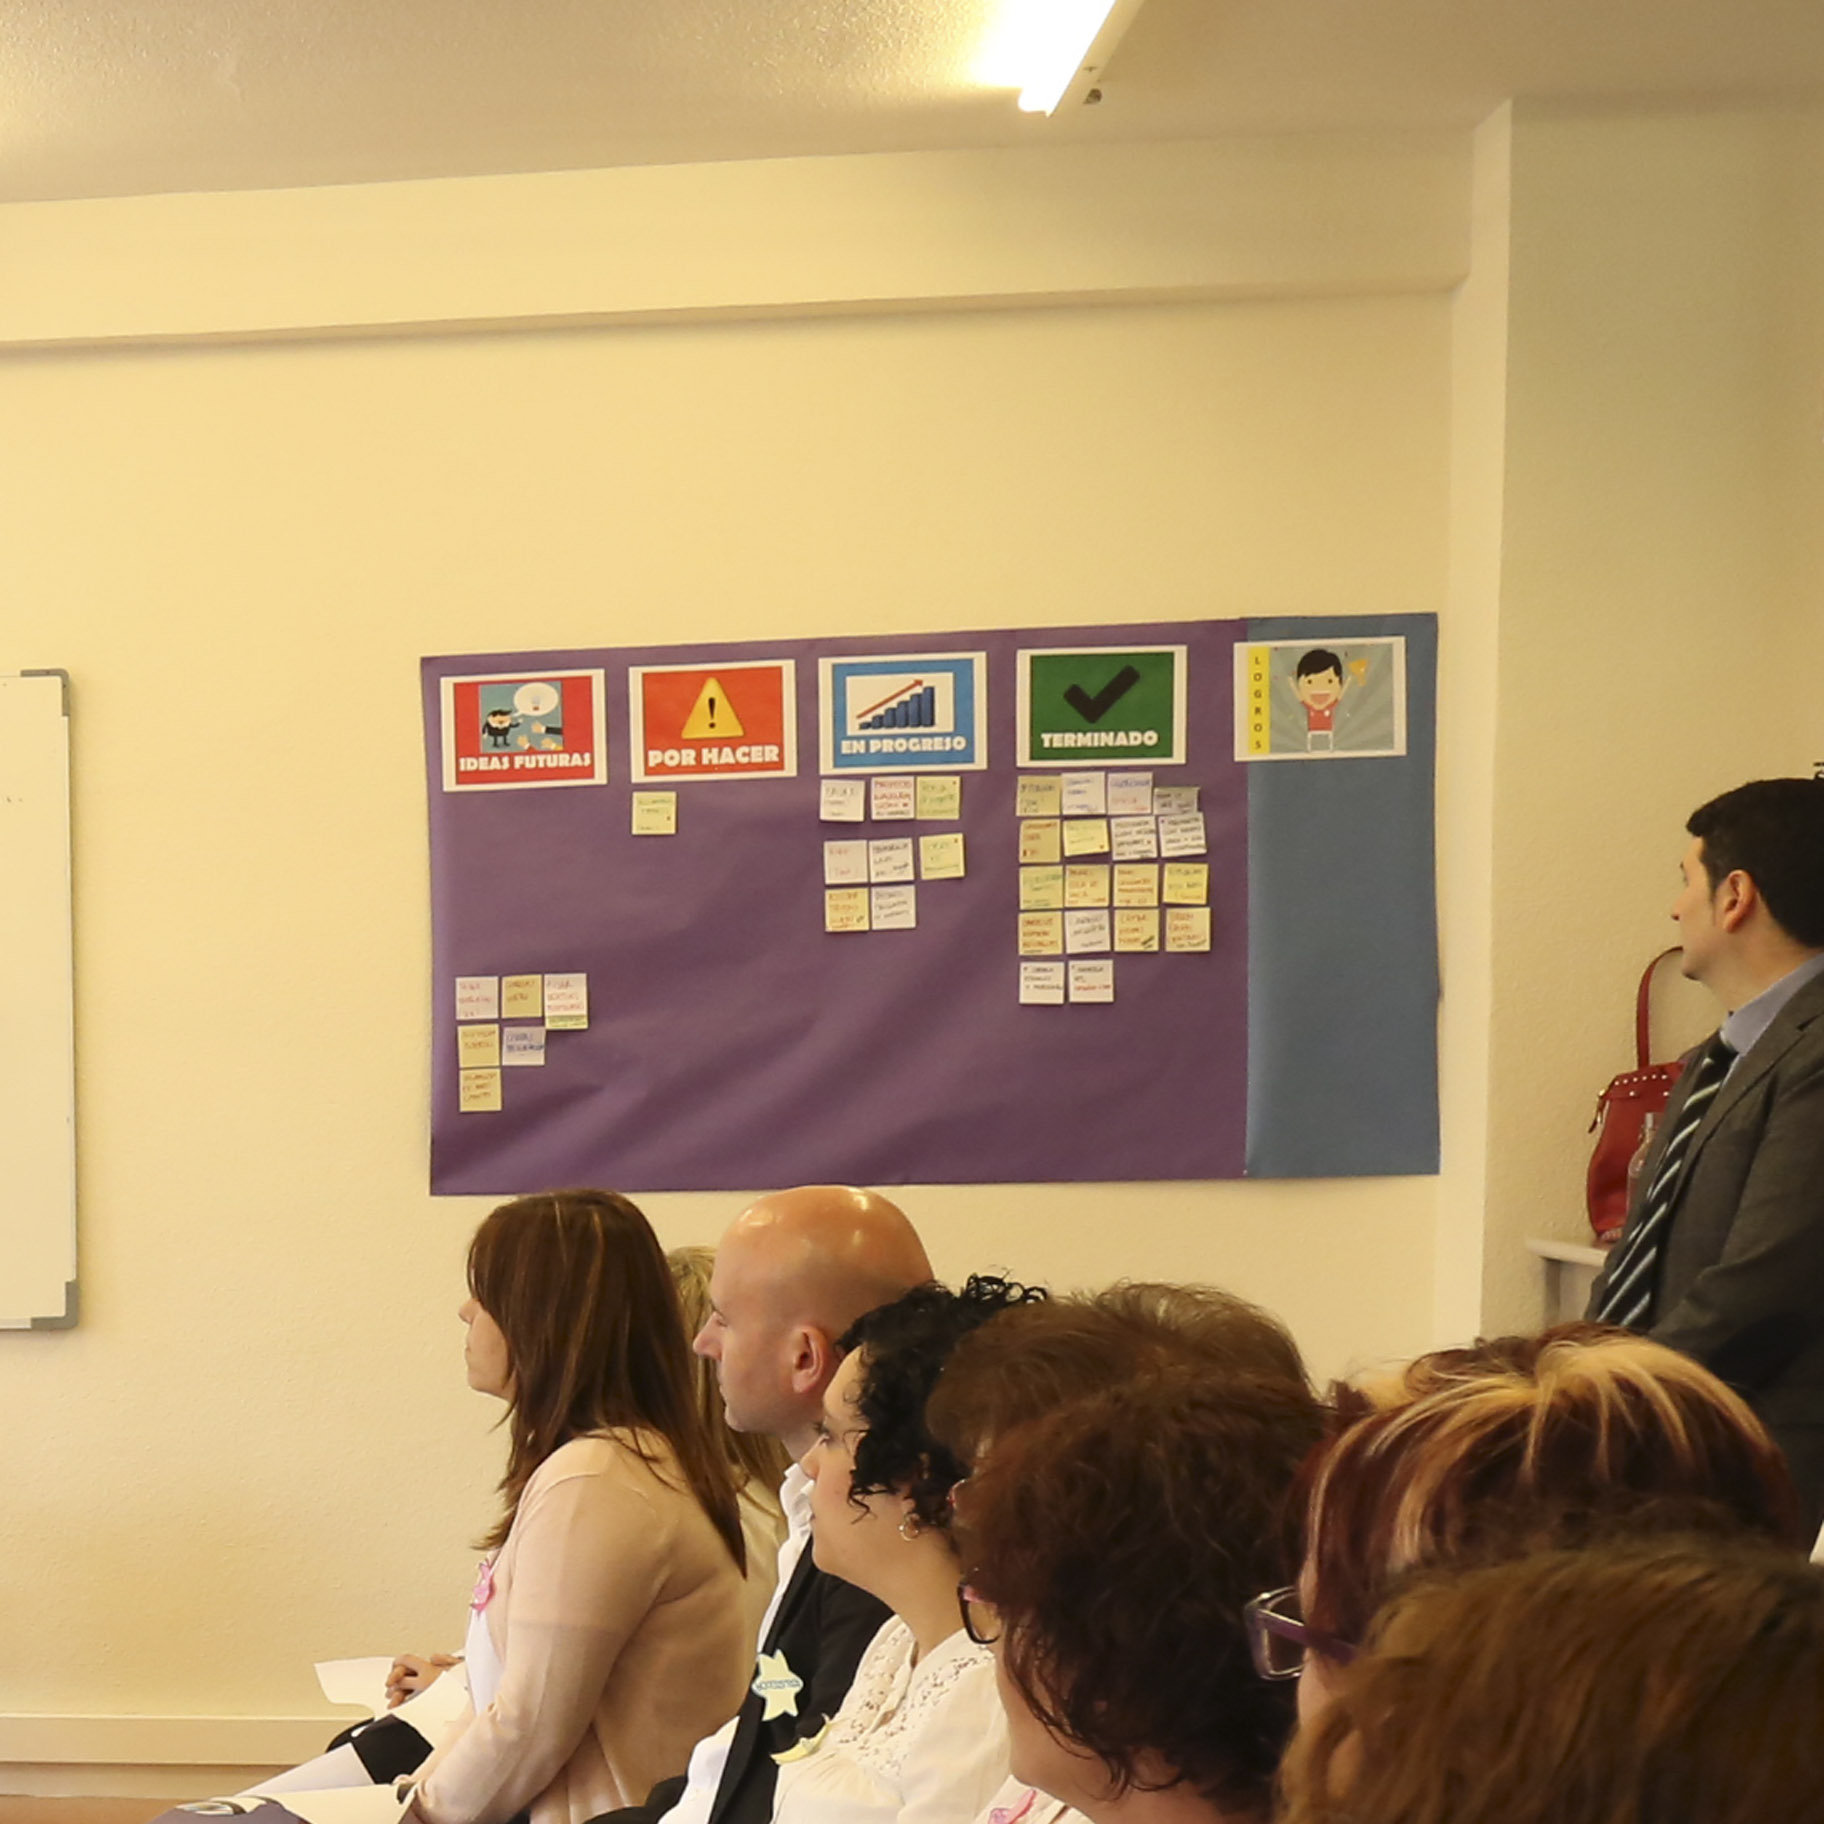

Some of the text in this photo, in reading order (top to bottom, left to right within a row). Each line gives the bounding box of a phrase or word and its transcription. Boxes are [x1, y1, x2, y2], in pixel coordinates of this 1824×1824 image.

[840, 735, 968, 755] EN PROGRESO
[1041, 730, 1160, 748] TERMINADO
[459, 752, 592, 773] IDEAS FUTURAS
[648, 745, 780, 768] POR HACER
